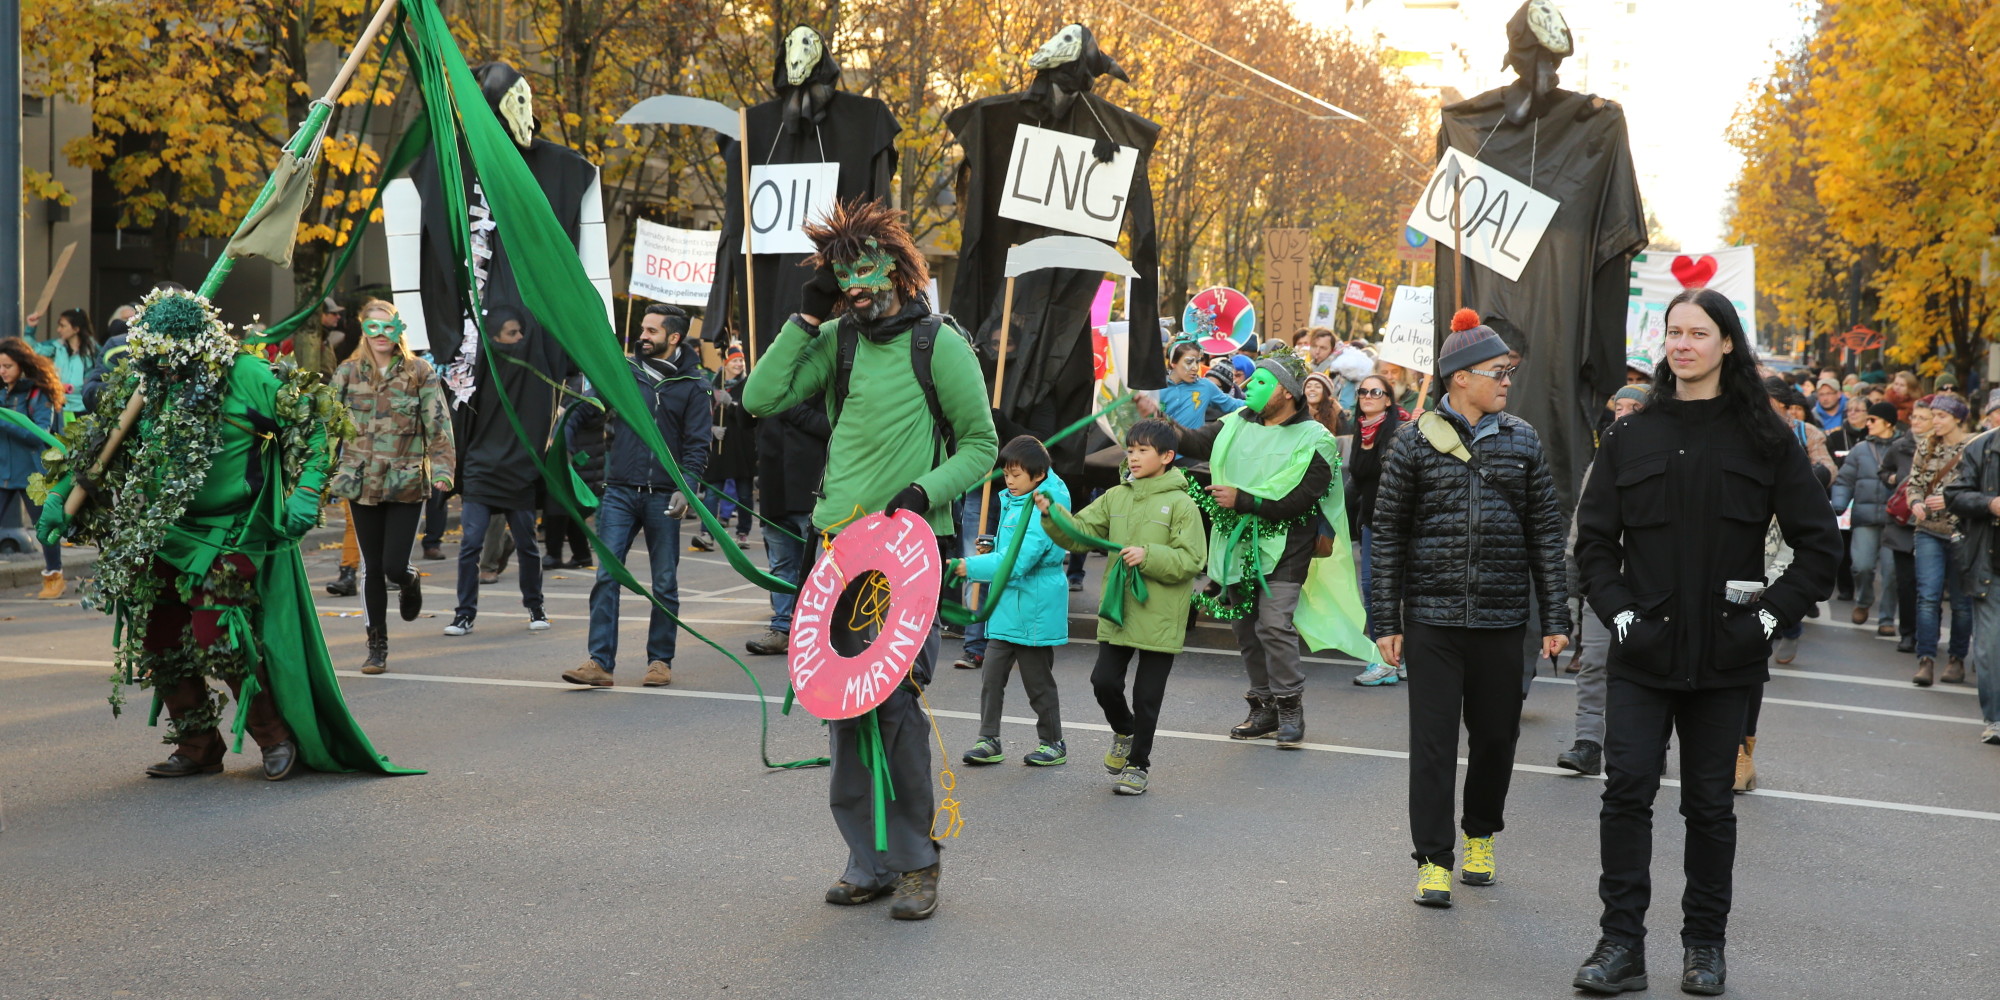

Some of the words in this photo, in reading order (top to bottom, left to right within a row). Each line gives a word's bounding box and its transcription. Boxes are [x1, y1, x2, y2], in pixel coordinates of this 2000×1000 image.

[750, 178, 829, 234] OIL
[1012, 137, 1125, 222] LNG
[1425, 167, 1529, 263] COAL
[646, 254, 717, 284] BROKE
[884, 516, 930, 588] LIFE
[793, 550, 836, 691] PROTECT
[842, 608, 927, 711] MARINE
